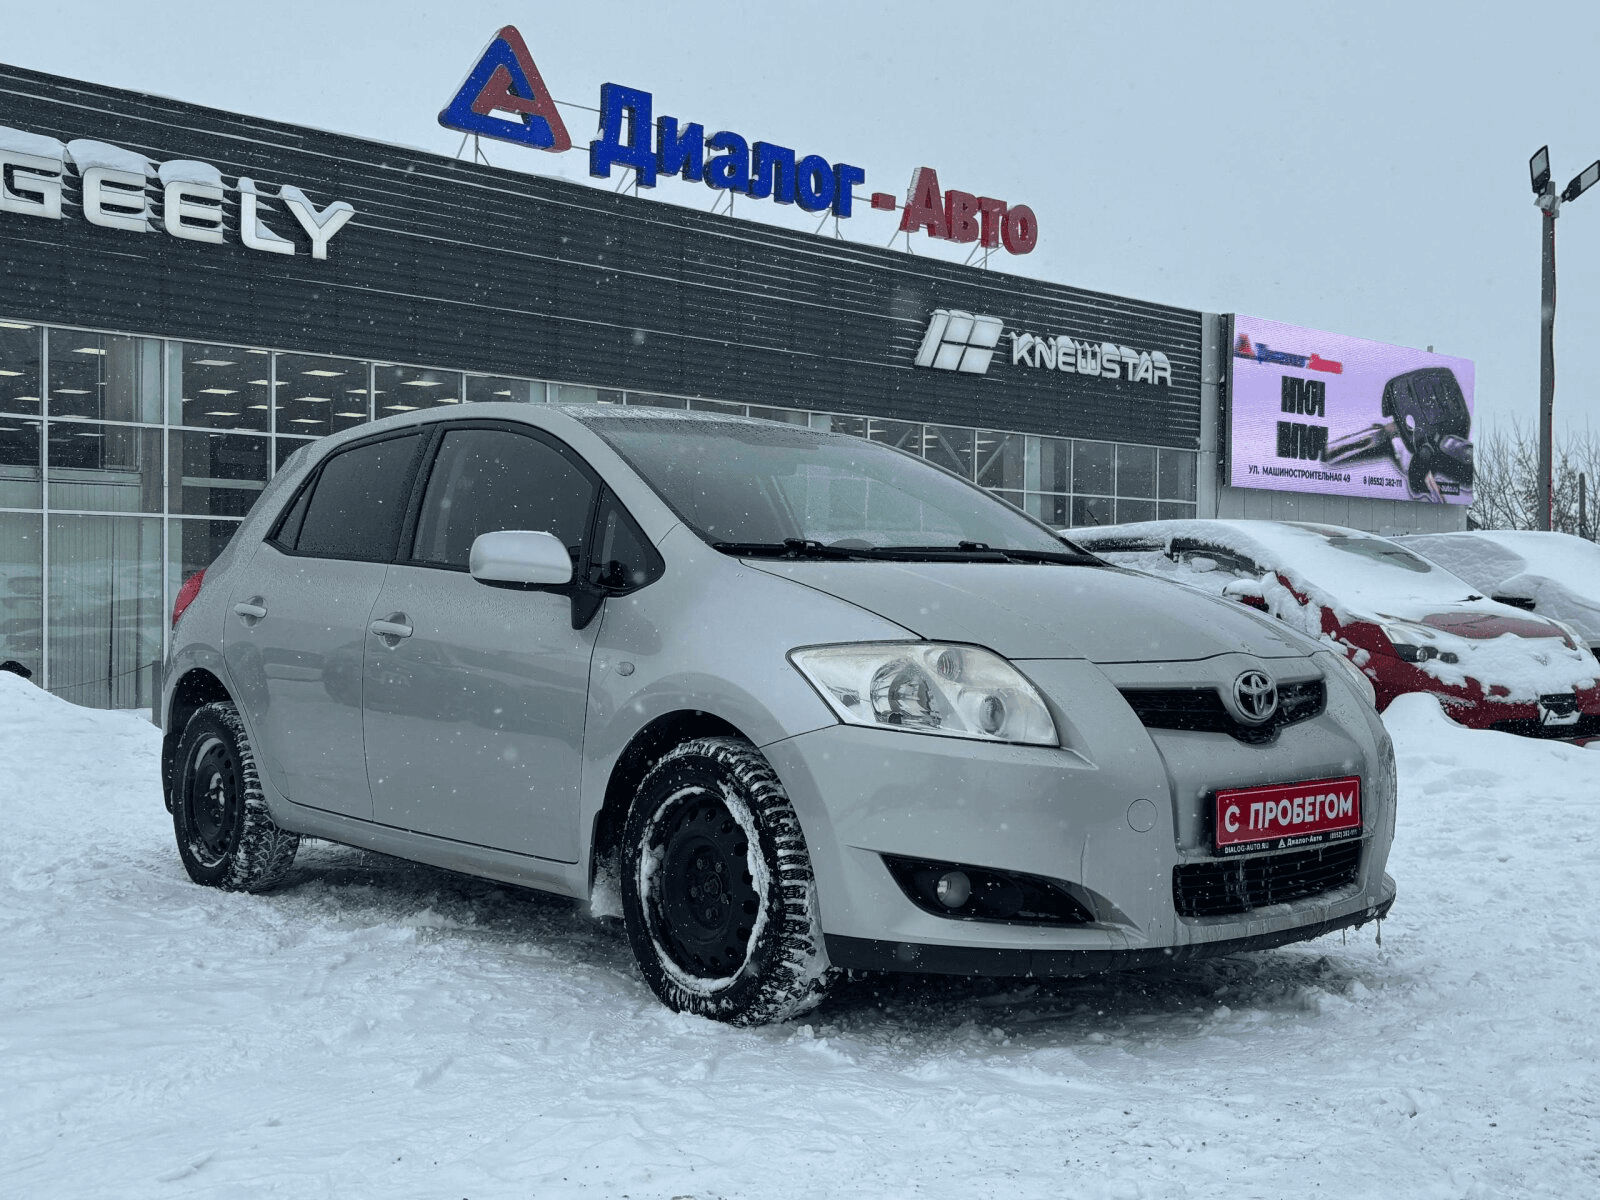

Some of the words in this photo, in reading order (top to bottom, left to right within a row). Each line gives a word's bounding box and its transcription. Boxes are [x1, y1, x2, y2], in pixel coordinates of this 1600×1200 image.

[589, 82, 1038, 255] Диалог-Авто
[0, 149, 355, 260] GEELY
[1010, 333, 1172, 387] KNEWSTAR
[1248, 464, 1260, 475] УЛ.
[1262, 466, 1343, 483] МАШИНОСТРОИТЕЛЬНАЯ
[1343, 473, 1351, 483] 49
[1224, 805, 1240, 832] С
[1249, 791, 1353, 829] ПРОБЕГОМ
[1225, 843, 1269, 853] DIALOG-AUTO.RU
